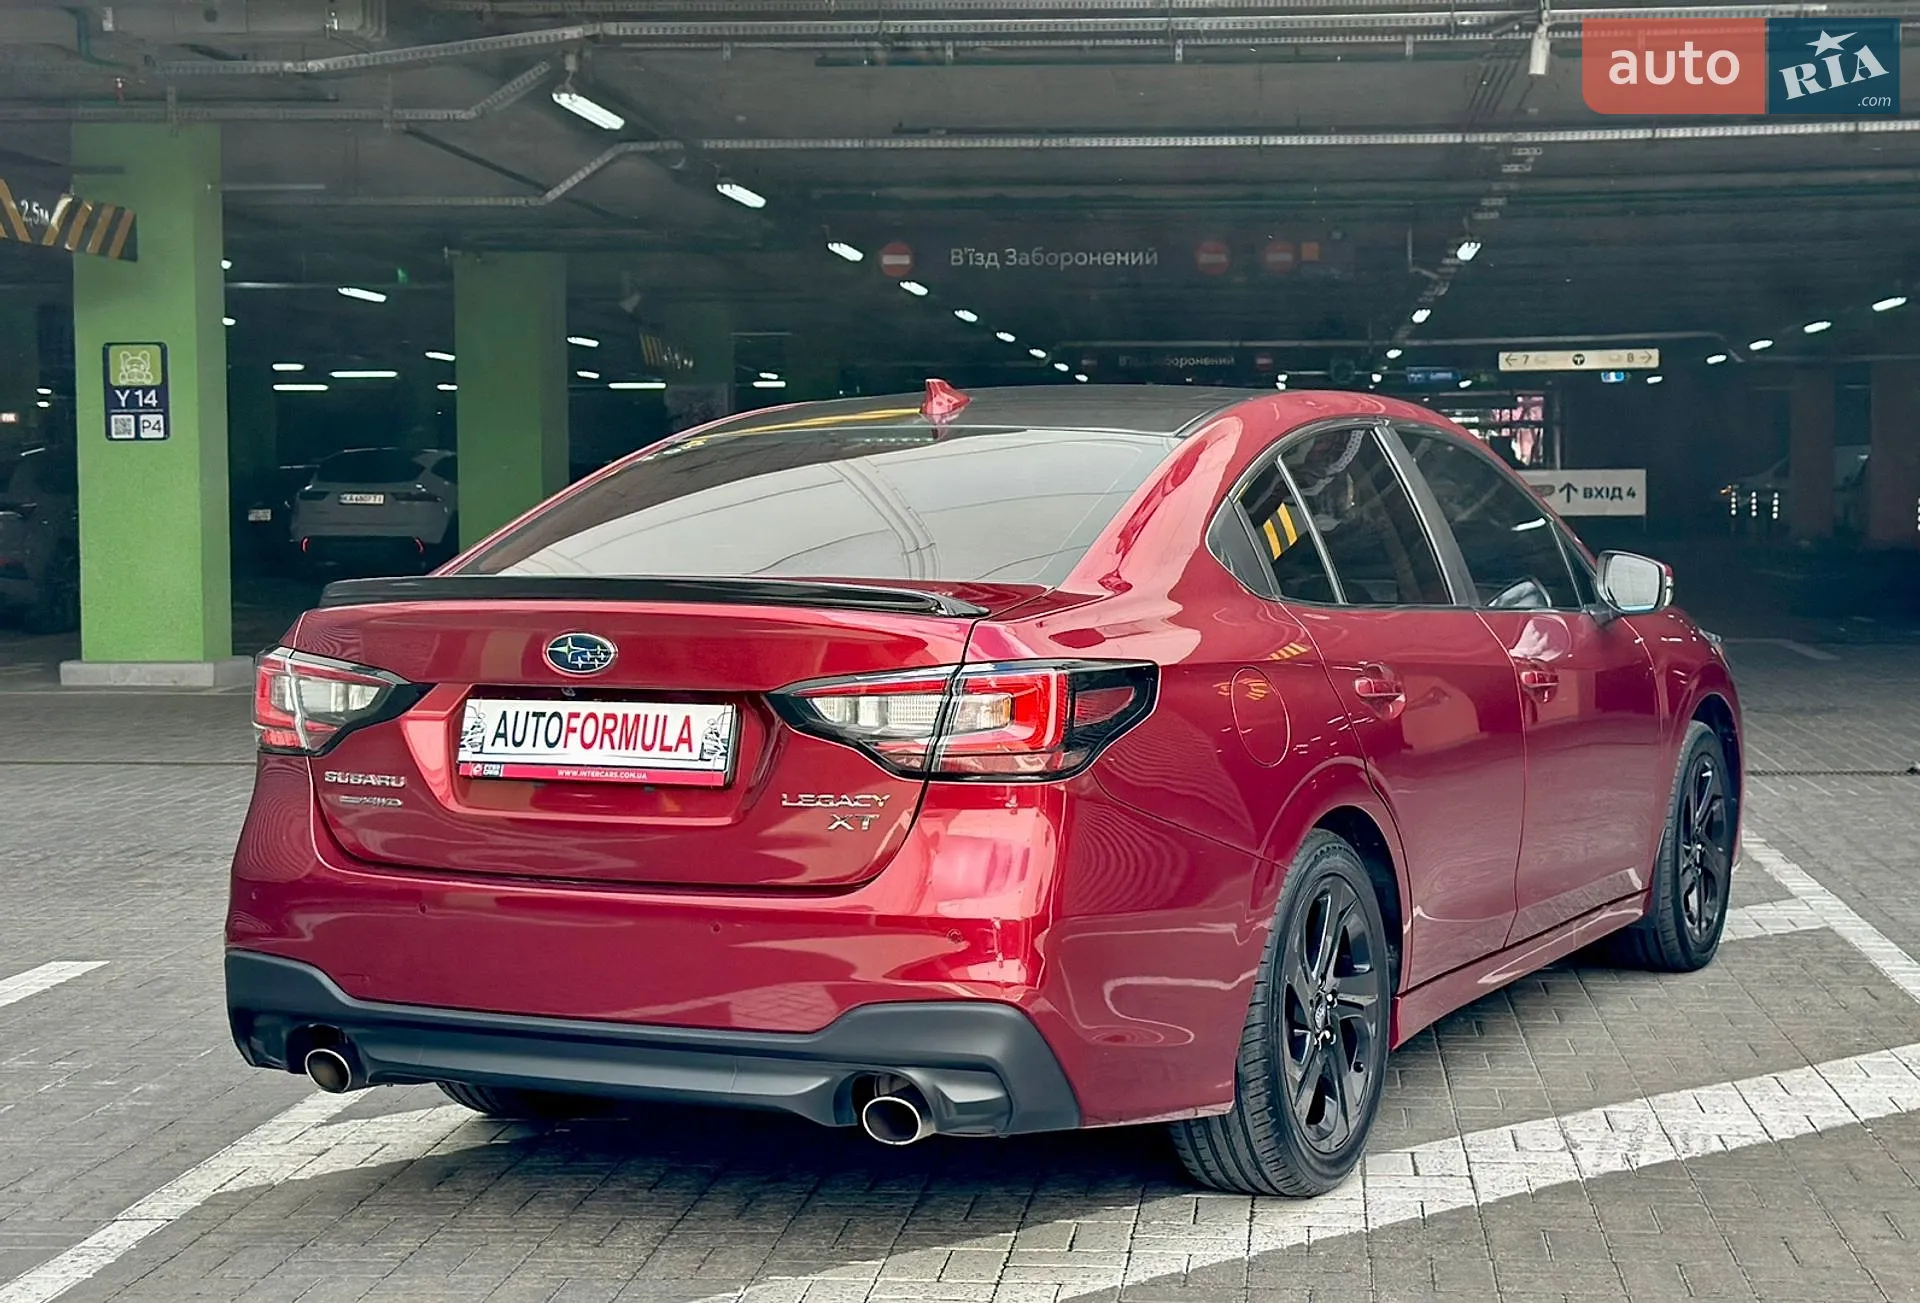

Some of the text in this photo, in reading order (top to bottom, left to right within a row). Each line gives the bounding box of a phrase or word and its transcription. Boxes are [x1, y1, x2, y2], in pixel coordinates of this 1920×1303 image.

[950, 246, 1159, 270] В'їзд Заборонений
[142, 419, 161, 433] P4
[1583, 487, 1636, 501] ВХІД 4
[491, 710, 693, 753] AUTOFORMULA
[324, 771, 406, 787] SUBARU
[557, 769, 647, 779] WWW.INTERCARS.COM.UA
[782, 793, 891, 808] LEGACY
[827, 813, 880, 830] XT
